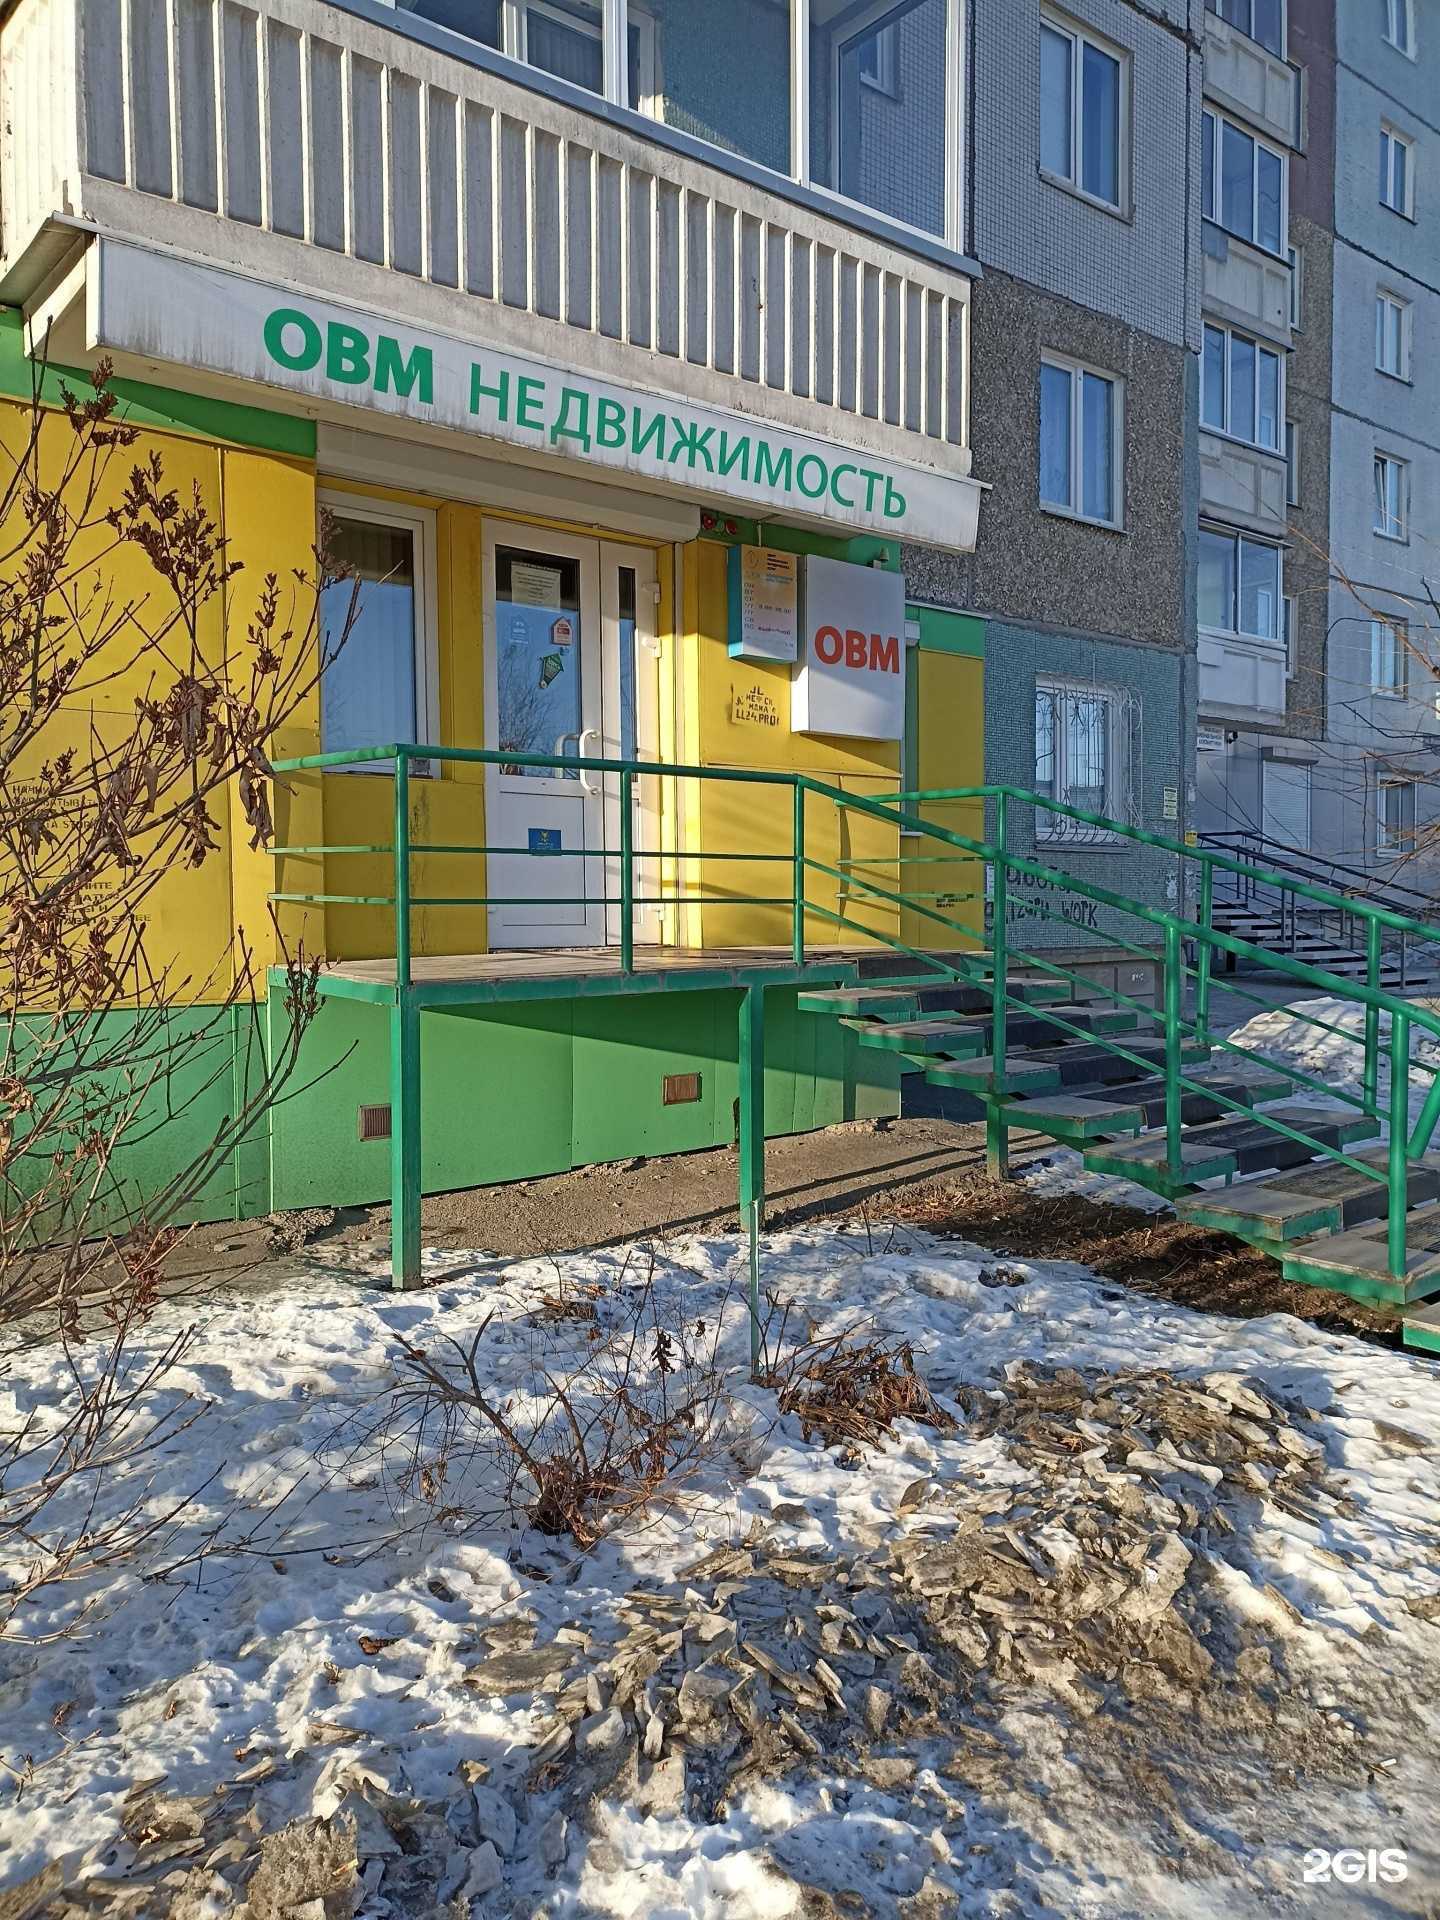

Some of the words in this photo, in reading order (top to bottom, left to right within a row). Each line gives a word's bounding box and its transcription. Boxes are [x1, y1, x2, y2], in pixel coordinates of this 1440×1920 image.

[264, 308, 433, 404] ОВМ
[470, 363, 906, 518] НЕДВИЖИМОСТЬ
[815, 626, 900, 674] ОВМ
